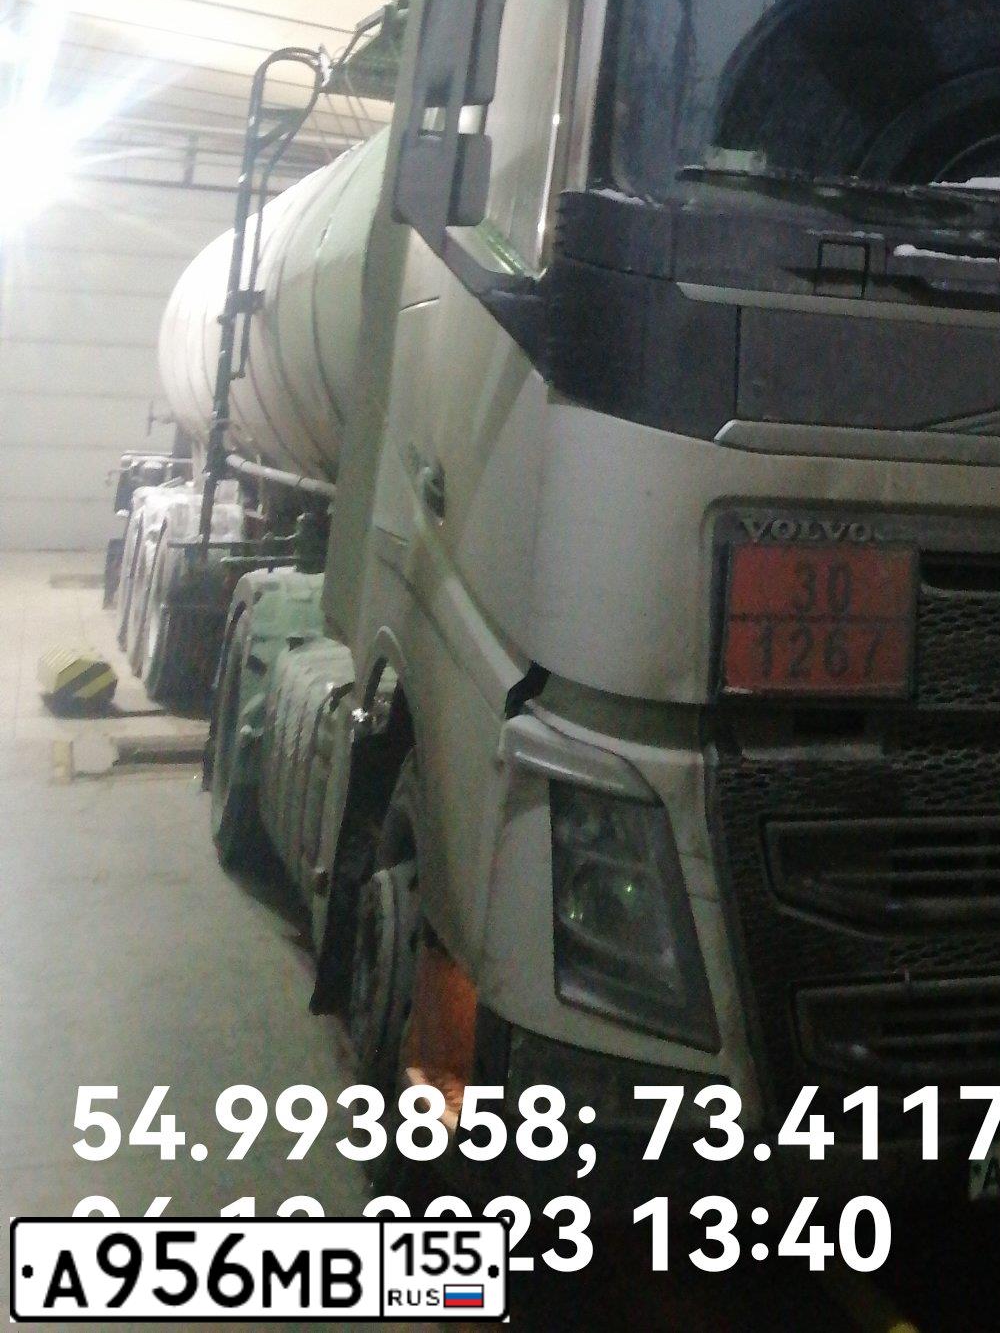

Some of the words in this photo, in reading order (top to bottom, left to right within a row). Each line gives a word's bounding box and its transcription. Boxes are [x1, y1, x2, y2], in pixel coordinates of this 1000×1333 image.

[739, 517, 872, 543] VOLVO
[791, 560, 853, 613] 30
[758, 621, 885, 679] 1267
